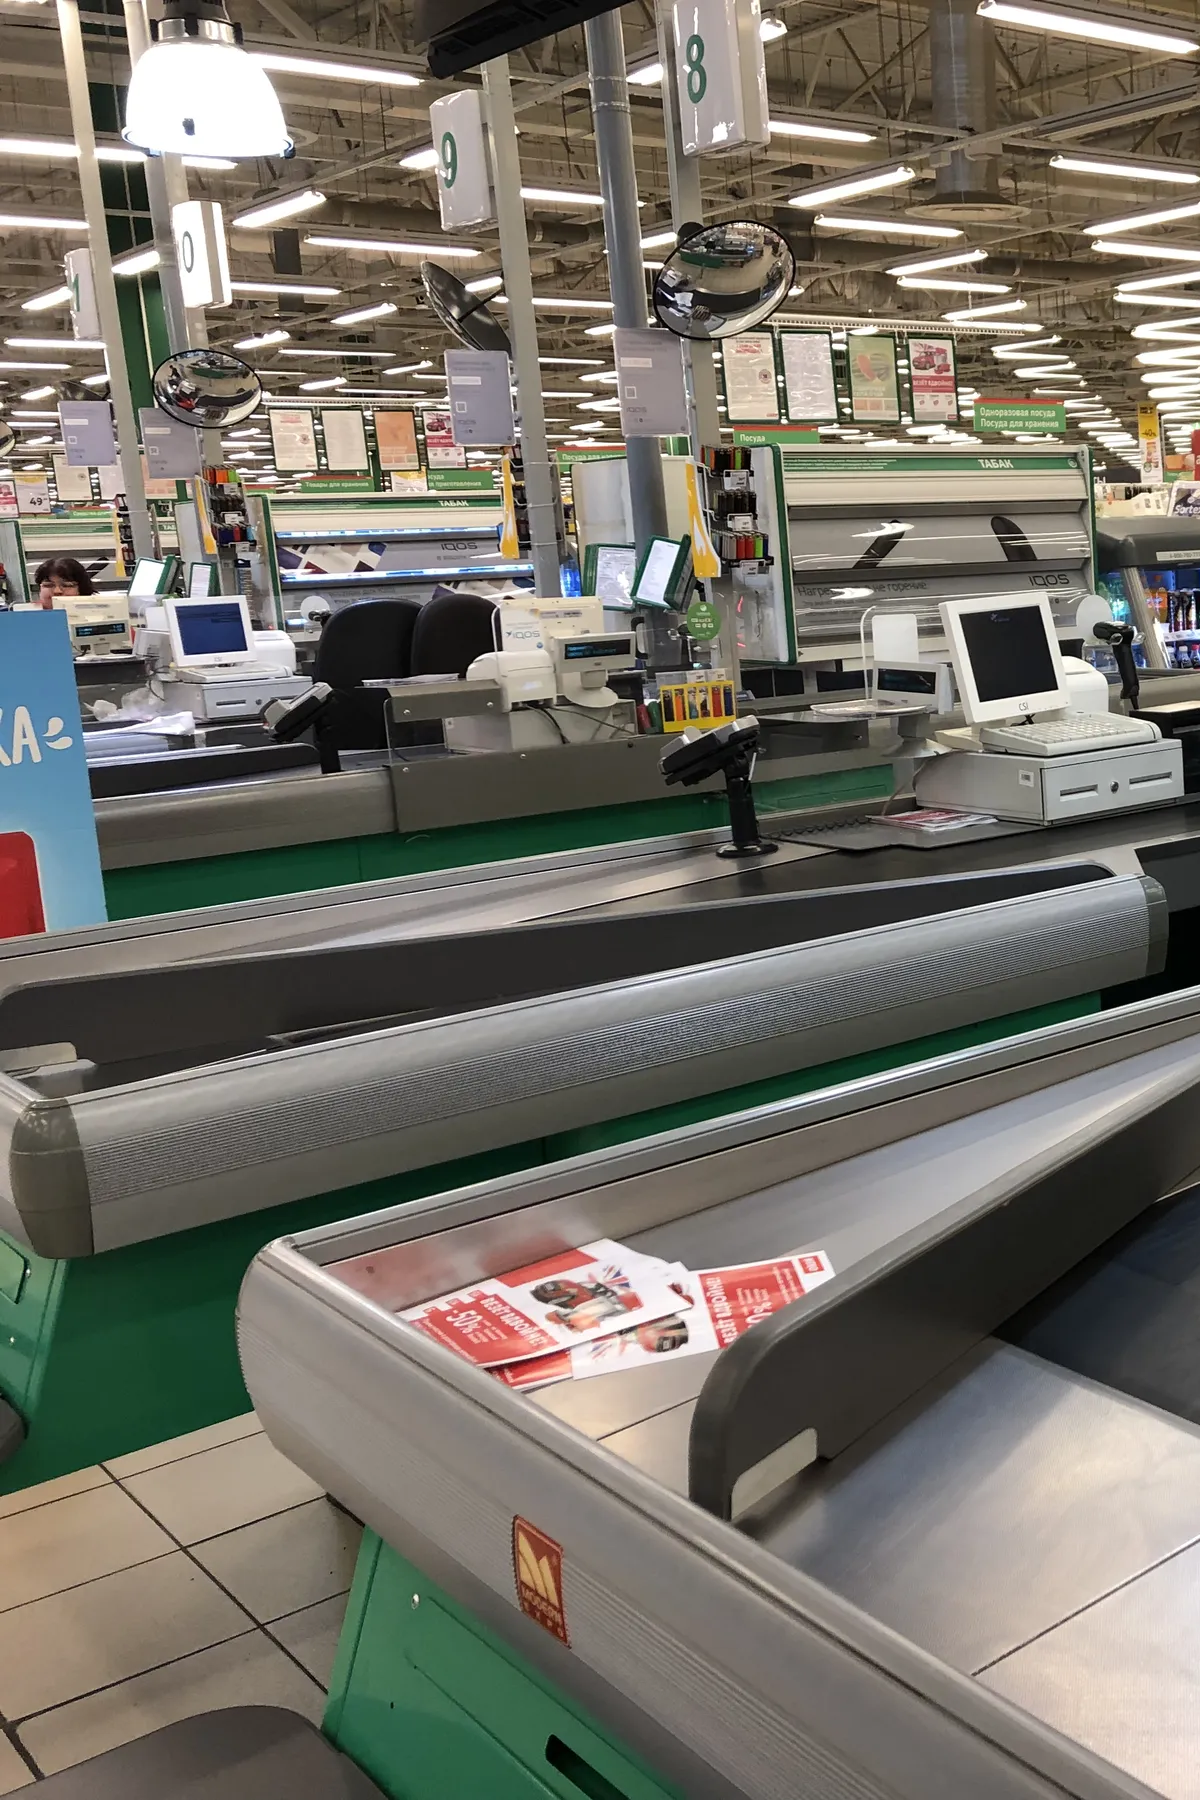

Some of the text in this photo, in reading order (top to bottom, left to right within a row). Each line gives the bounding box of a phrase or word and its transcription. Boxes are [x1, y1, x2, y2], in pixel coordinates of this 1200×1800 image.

[686, 34, 707, 104] 8
[441, 131, 457, 189] 9
[980, 407, 1056, 418] Одноразовая посуда
[980, 418, 1060, 429] Посуда для хранения
[739, 433, 766, 443] Посуда
[978, 459, 1014, 469] ТАБАК
[29, 497, 43, 506] 49
[438, 500, 469, 508] ТАБАК
[440, 541, 478, 552] IQOS
[1027, 573, 1070, 588] IQOS
[512, 630, 541, 640] IQOS
[445, 1309, 484, 1334] -50%
